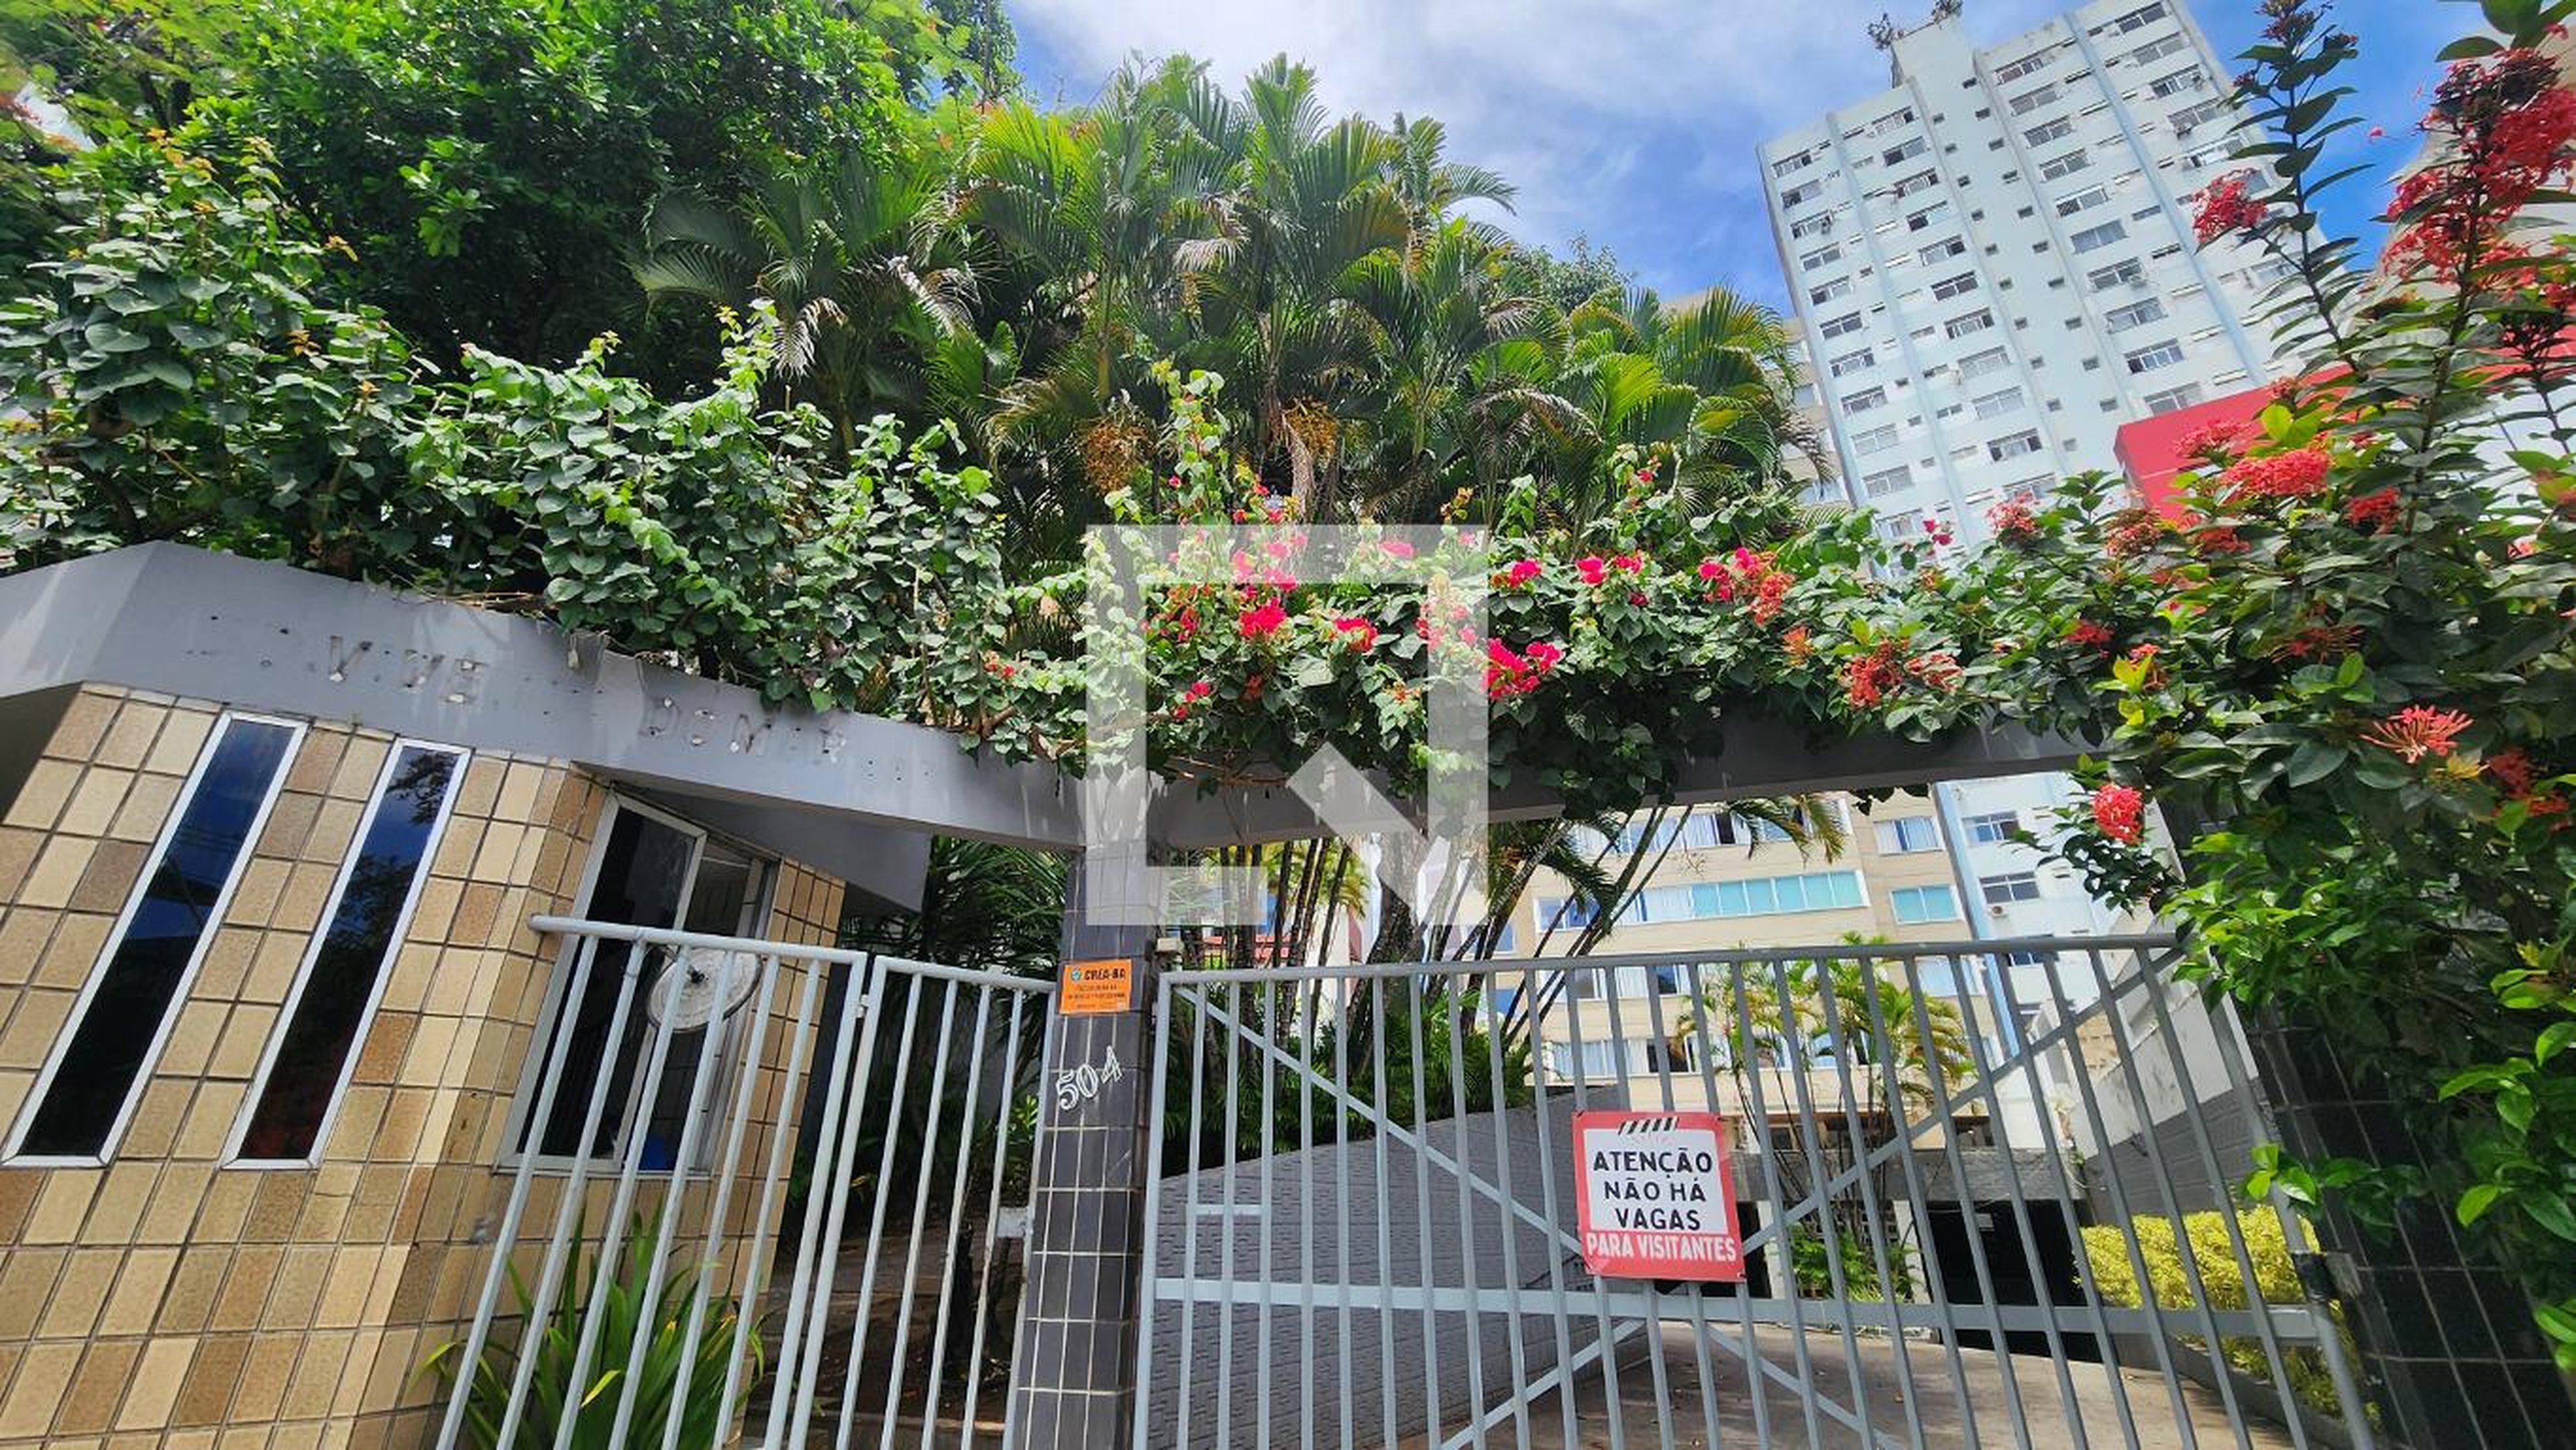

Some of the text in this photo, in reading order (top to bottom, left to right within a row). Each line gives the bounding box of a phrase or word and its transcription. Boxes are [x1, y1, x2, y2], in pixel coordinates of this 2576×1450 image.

[1055, 1045, 1123, 1111] 504
[1593, 1147, 1713, 1178] ATENÇÃO
[1604, 1177, 1706, 1202] NÃO HÁ
[1615, 1208, 1701, 1231] VAGAS
[1586, 1232, 1737, 1262] PARA VISITANTES
